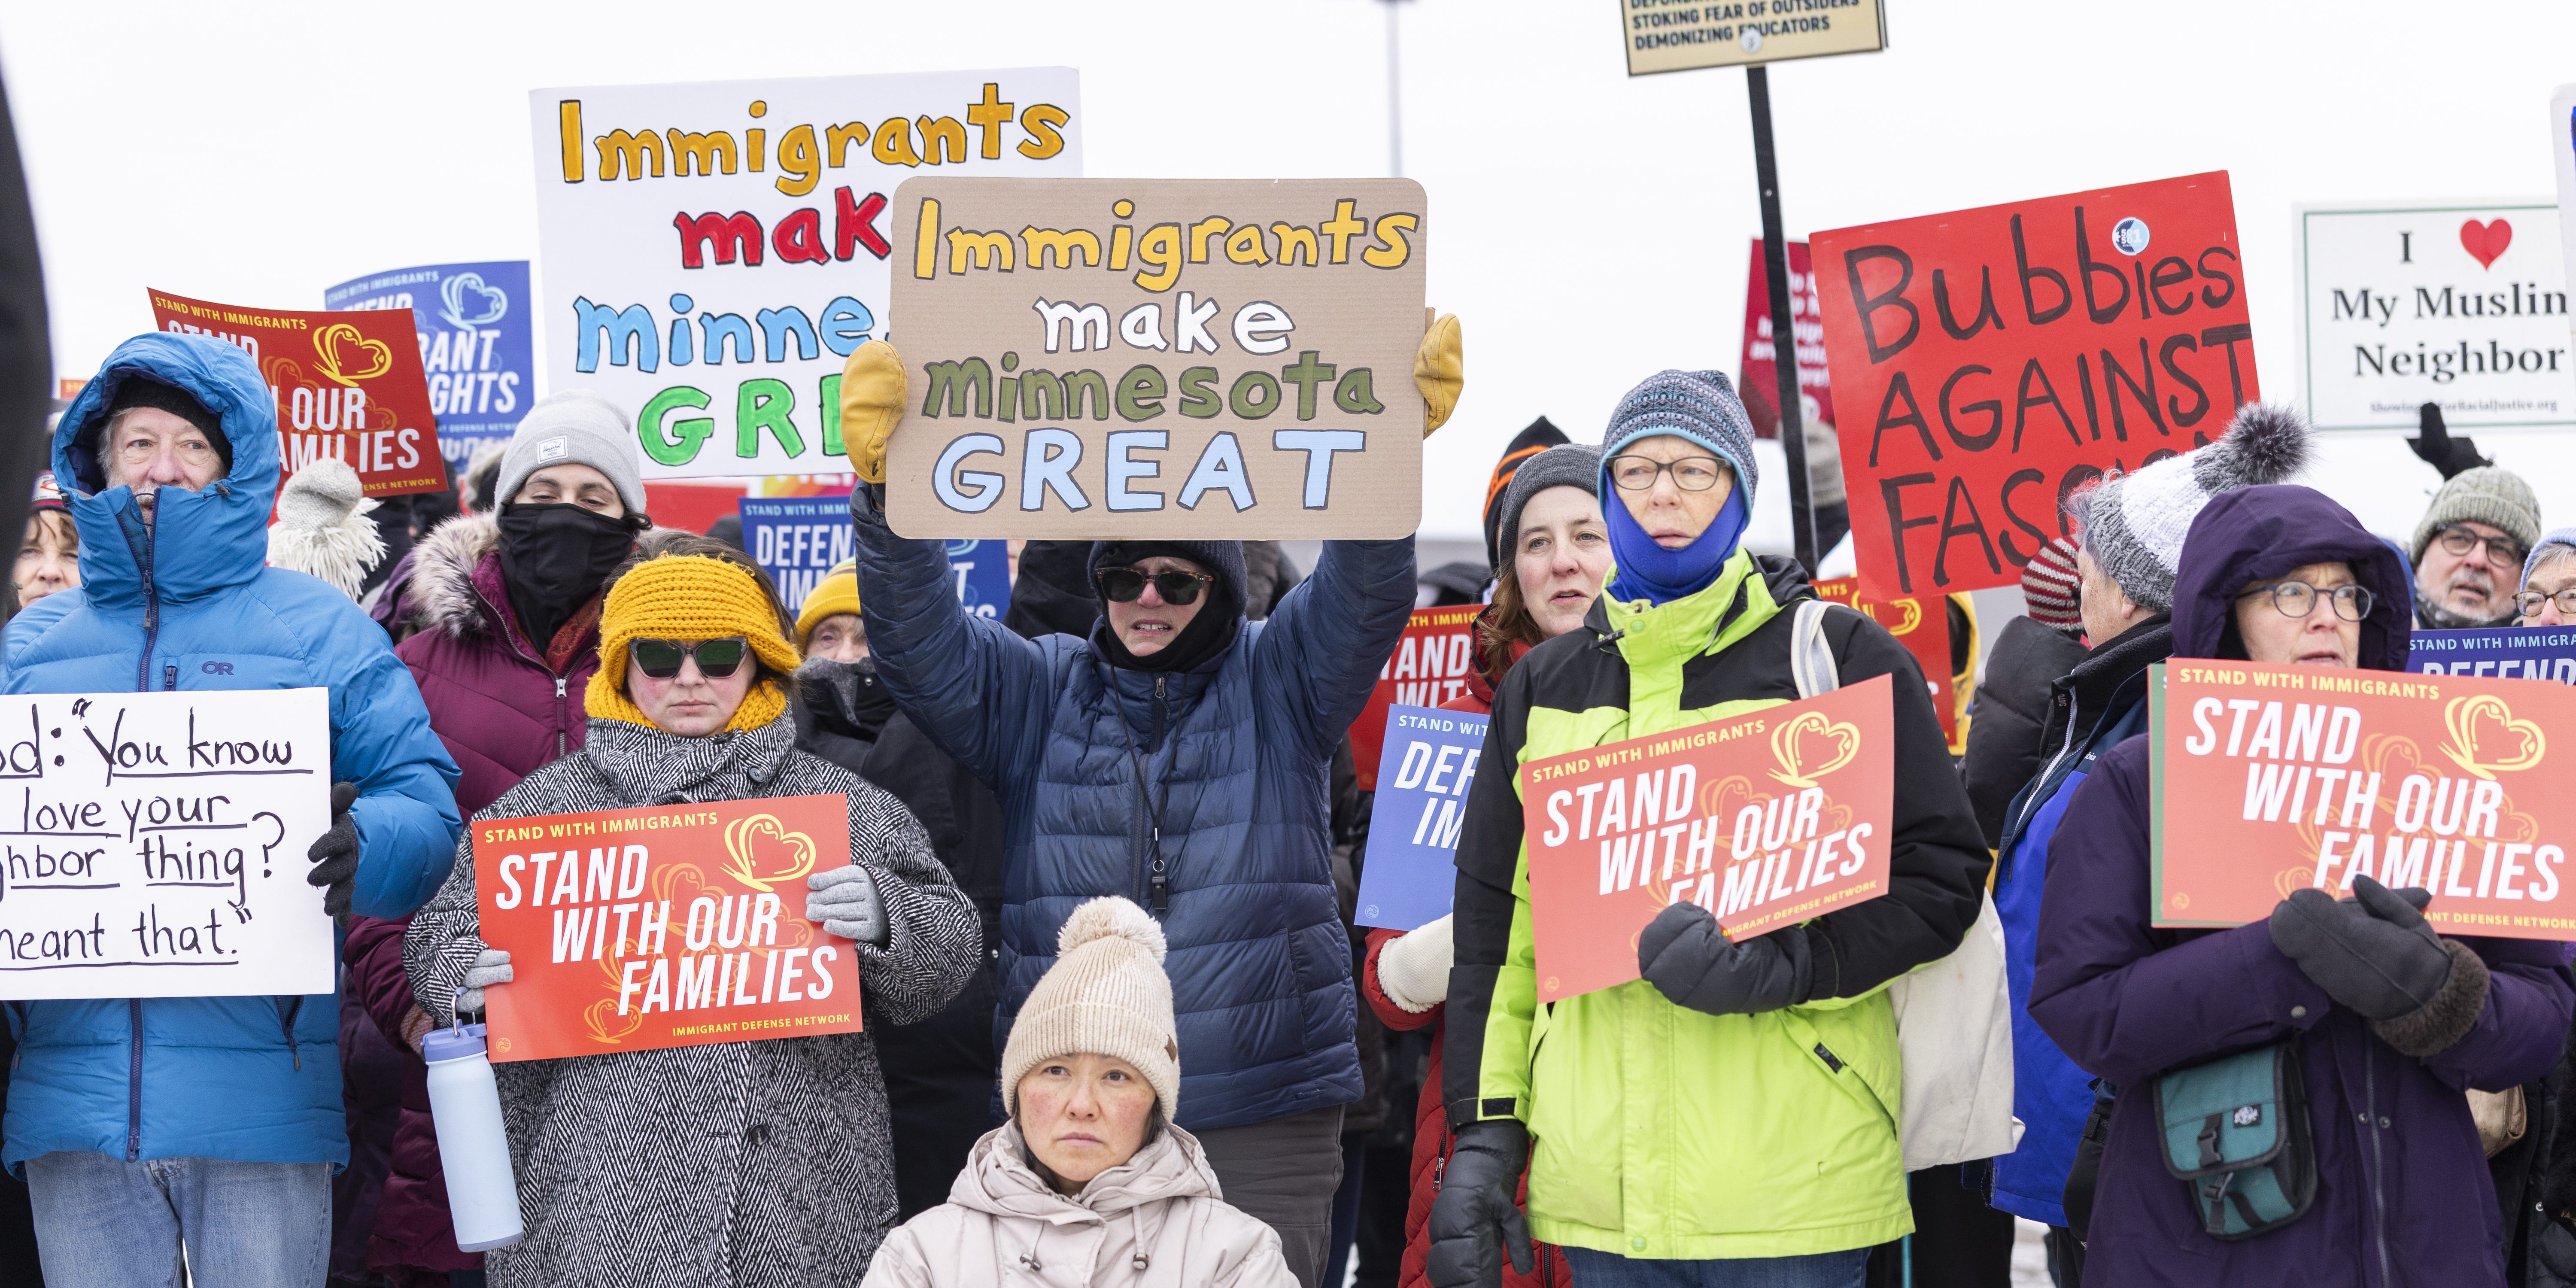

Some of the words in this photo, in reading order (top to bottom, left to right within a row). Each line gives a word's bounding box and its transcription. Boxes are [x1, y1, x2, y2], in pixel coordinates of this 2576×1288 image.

[1633, 9, 1699, 30] STOKING
[1705, 4, 1742, 21] FEAR
[1749, 2, 1766, 17] OF
[1635, 27, 1733, 50] DEMONIZING
[560, 82, 1071, 196] Immigrants
[674, 185, 892, 268] mak
[914, 197, 1420, 292] Immigrants
[2399, 231, 2414, 264] I
[370, 270, 439, 291] IMMIGRANTS
[1844, 206, 2236, 364] Bubbies
[156, 296, 188, 314] STAND
[191, 305, 220, 321] WITH
[224, 312, 307, 330] IMMIGRANTS
[1032, 291, 1296, 355] make
[2332, 287, 2399, 328] My
[573, 293, 890, 373] minne
[2354, 340, 2565, 384] Neighbor
[292, 387, 366, 431] OUR
[428, 371, 520, 415] GHTS
[1869, 323, 2251, 468] AGAINST
[363, 481, 387, 491] ENSE
[390, 478, 437, 489] NETWORK
[931, 427, 1367, 513] GREAT
[745, 504, 782, 516] STAND
[784, 504, 815, 515] WITH
[756, 523, 856, 568] DEFEN
[1433, 612, 1477, 626] IMMIG
[1380, 634, 1471, 680] AND
[2410, 639, 2457, 651] STAND
[2462, 637, 2501, 649] WITH
[2508, 635, 2576, 648] IMMIGRA
[202, 661, 234, 675] OR
[2180, 668, 2247, 686] STAND
[2253, 672, 2305, 690] WITH
[2312, 675, 2439, 700] IMMIGRANTS
[188, 706, 292, 769] know
[1398, 715, 1453, 732] STAND
[1460, 722, 1488, 737] WIT
[2185, 697, 2361, 764] STAND
[1394, 741, 1481, 796] DEF
[1532, 759, 1590, 783] STAND
[1595, 747, 1642, 769] WITH
[1648, 720, 1765, 758] IMMIGRANTS
[25, 787, 106, 832] love
[121, 795, 230, 843] your
[1543, 764, 1696, 847] STAND
[2242, 763, 2382, 829] WITH
[2394, 774, 2503, 838] OUR
[485, 826, 545, 843] STAND
[549, 822, 595, 838] WITH
[602, 812, 718, 833] IMMIGRANTS
[1599, 815, 1718, 896] WITH
[1732, 787, 1824, 860] OUR
[0, 844, 105, 891] hbor
[496, 844, 649, 910] STAND
[2313, 830, 2564, 902] FAMILIES
[552, 899, 670, 964] WITH
[685, 893, 781, 951] OUR
[1722, 914, 1771, 936] MIGRANT
[1773, 898, 1821, 921] DEFENSE
[1823, 880, 1877, 904] NETWORK
[2453, 913, 2509, 925] DEFENSE
[2514, 915, 2576, 929] NETWORK
[618, 945, 837, 1016] FAMILIES
[672, 1023, 738, 1037] IMMIGRANT
[742, 1018, 792, 1031] DEFENSE
[795, 1014, 851, 1028] NETWORK
